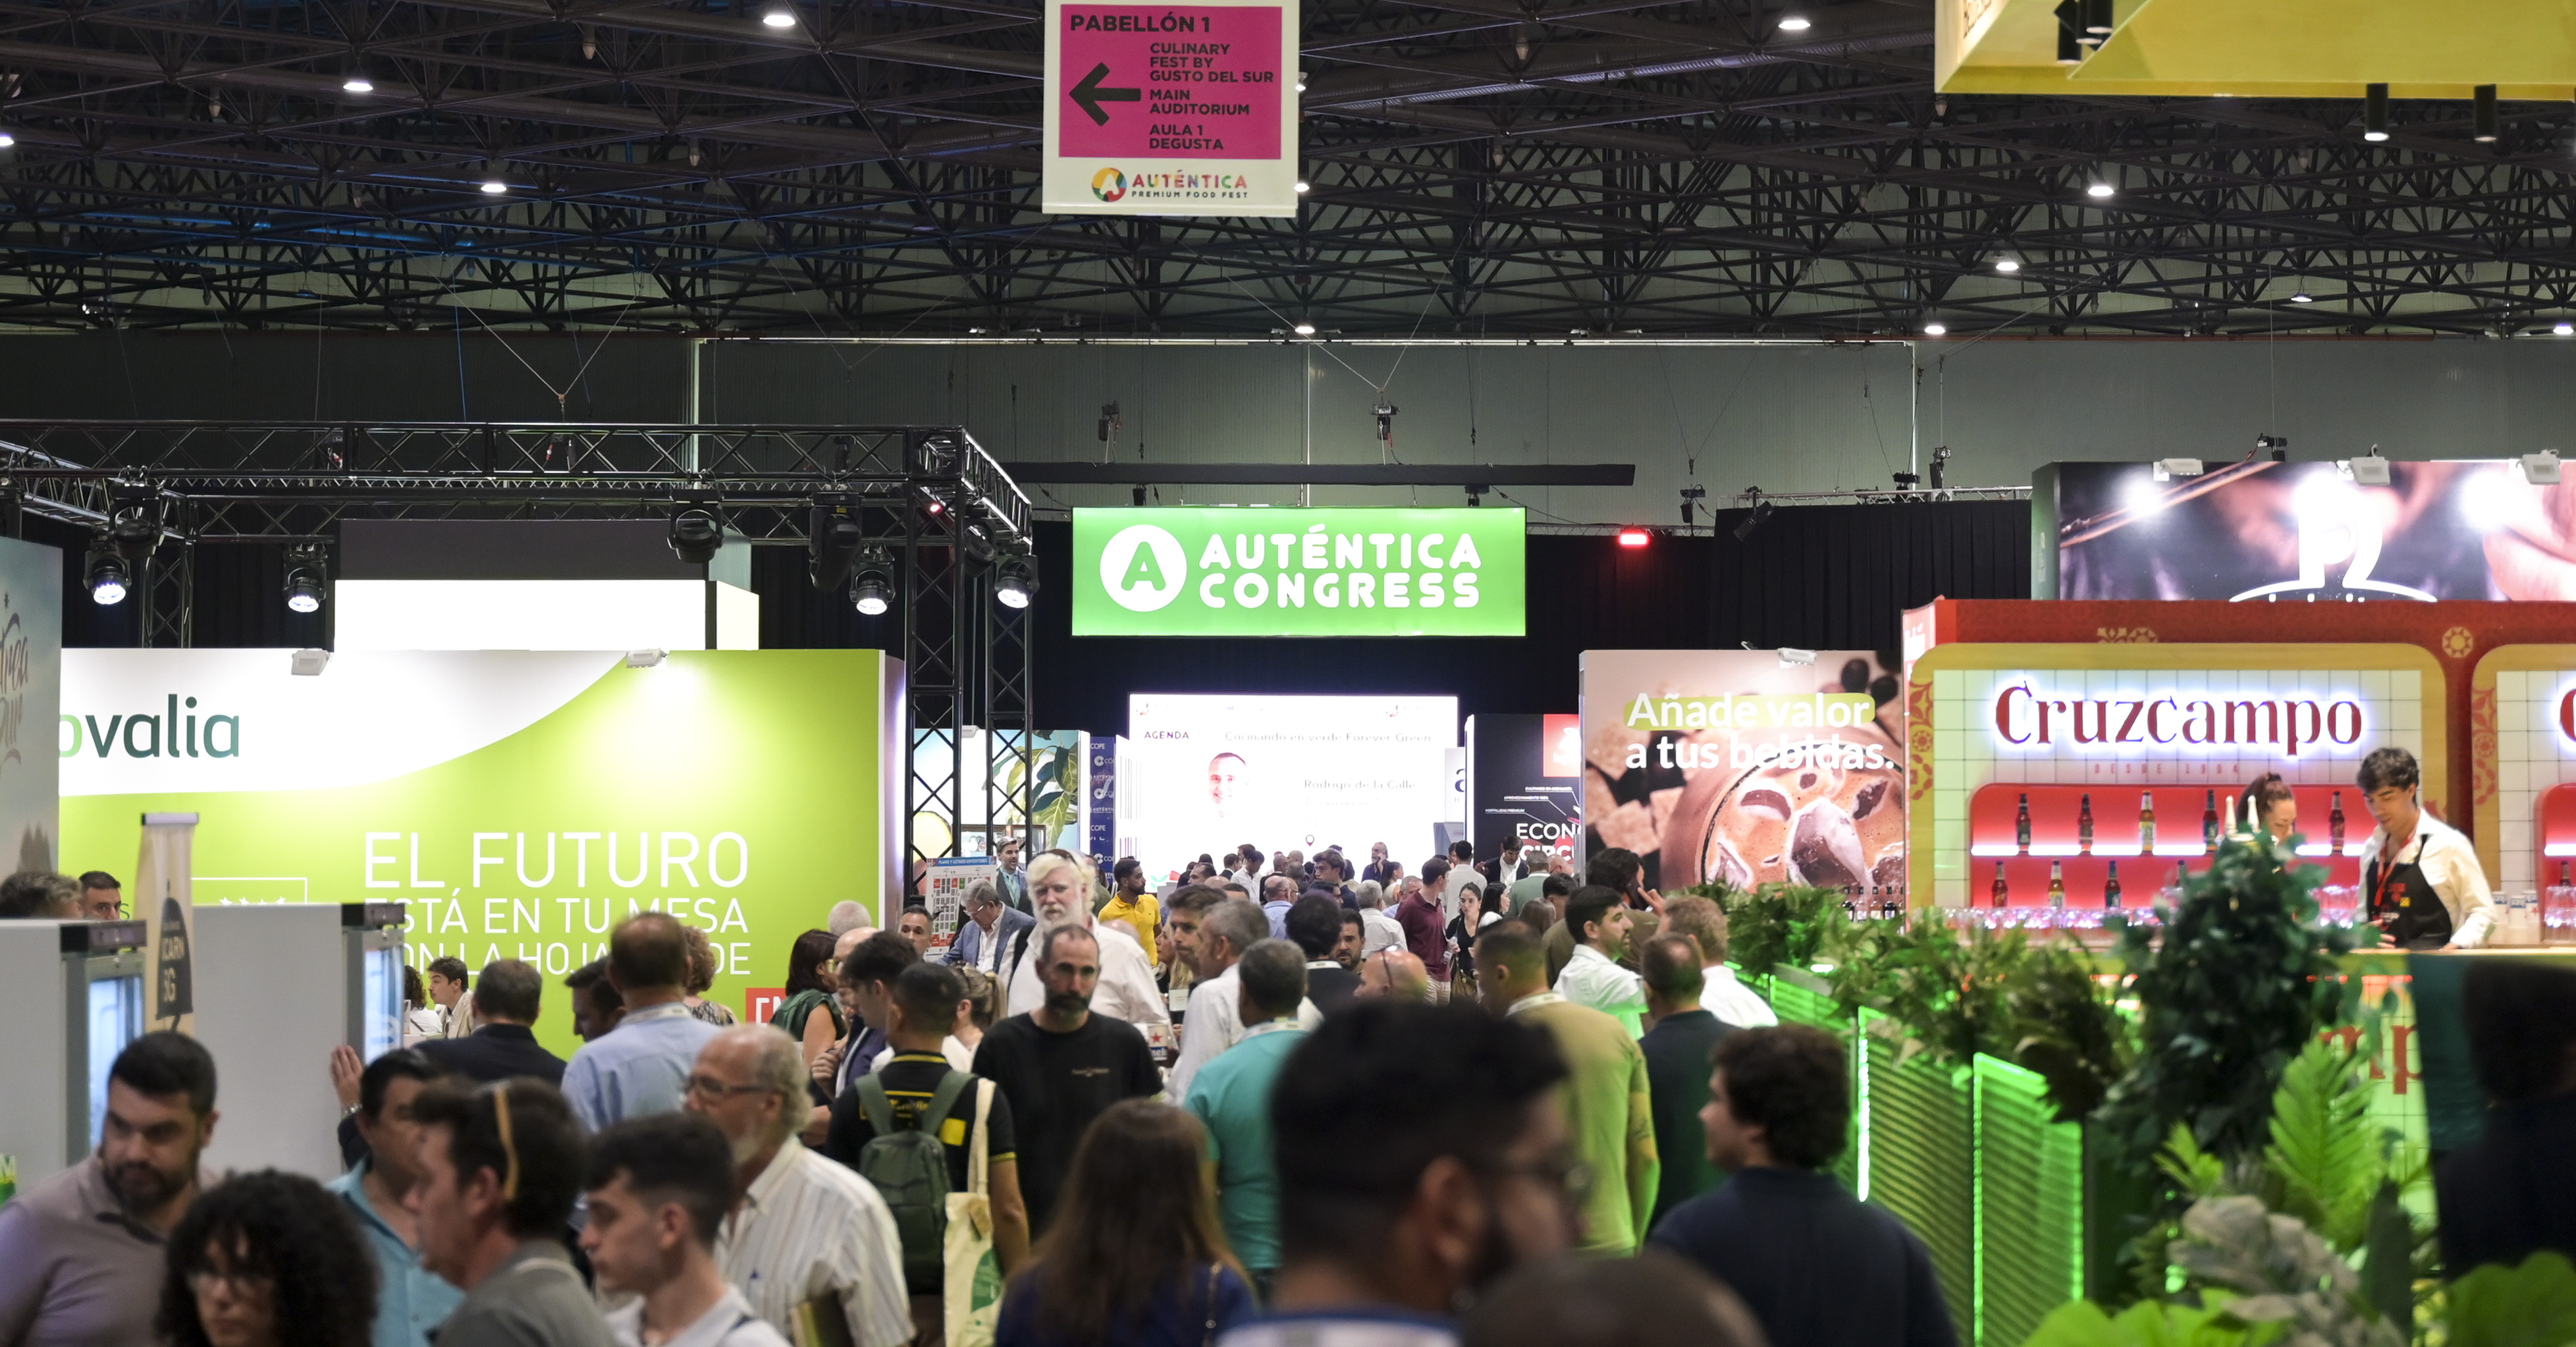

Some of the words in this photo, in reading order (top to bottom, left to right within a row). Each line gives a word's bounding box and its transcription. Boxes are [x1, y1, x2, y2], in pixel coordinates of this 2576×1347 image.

[1070, 11, 1194, 32] PABELLÓN
[1202, 17, 1210, 32] 1
[1150, 42, 1230, 55] CULINARY
[1150, 57, 1189, 68] FEST
[1193, 57, 1214, 69] BY
[1149, 70, 1204, 82] GUSTO
[1208, 70, 1239, 82] DEL
[1242, 71, 1274, 83] SUR
[1149, 89, 1191, 101] MAIN
[1149, 103, 1250, 115] AUDITORIUM
[1149, 124, 1193, 136] AULA
[1197, 124, 1203, 136] 1
[1149, 138, 1224, 150] DEGUSTA
[1132, 169, 1247, 189] AUTÉNTICA
[1199, 523, 1482, 570] AUTÉNTICA
[1199, 572, 1480, 609] CONGRESS
[1626, 692, 1758, 728] Añade
[1765, 692, 1870, 728] valor
[1995, 680, 2362, 757] Cruzcampo
[1144, 730, 1189, 740] AGENDA
[1225, 731, 1287, 742] Cocinando
[1308, 732, 1342, 742] verde
[1346, 732, 1391, 742] Forever
[1395, 732, 1431, 743] Green
[1624, 743, 1647, 770] a
[1655, 736, 1720, 770] tus
[1729, 734, 1895, 770] bebidas.
[1304, 779, 1351, 791] Rodrigo
[1355, 779, 1370, 790] de
[1374, 779, 1383, 790] la
[1387, 779, 1416, 790] Calle
[1516, 823, 1581, 840] ECON
[365, 831, 445, 889] EL
[472, 831, 748, 889] FUTURO
[365, 887, 469, 934] STÁ
[485, 898, 540, 934] EN
[556, 898, 610, 934] TU
